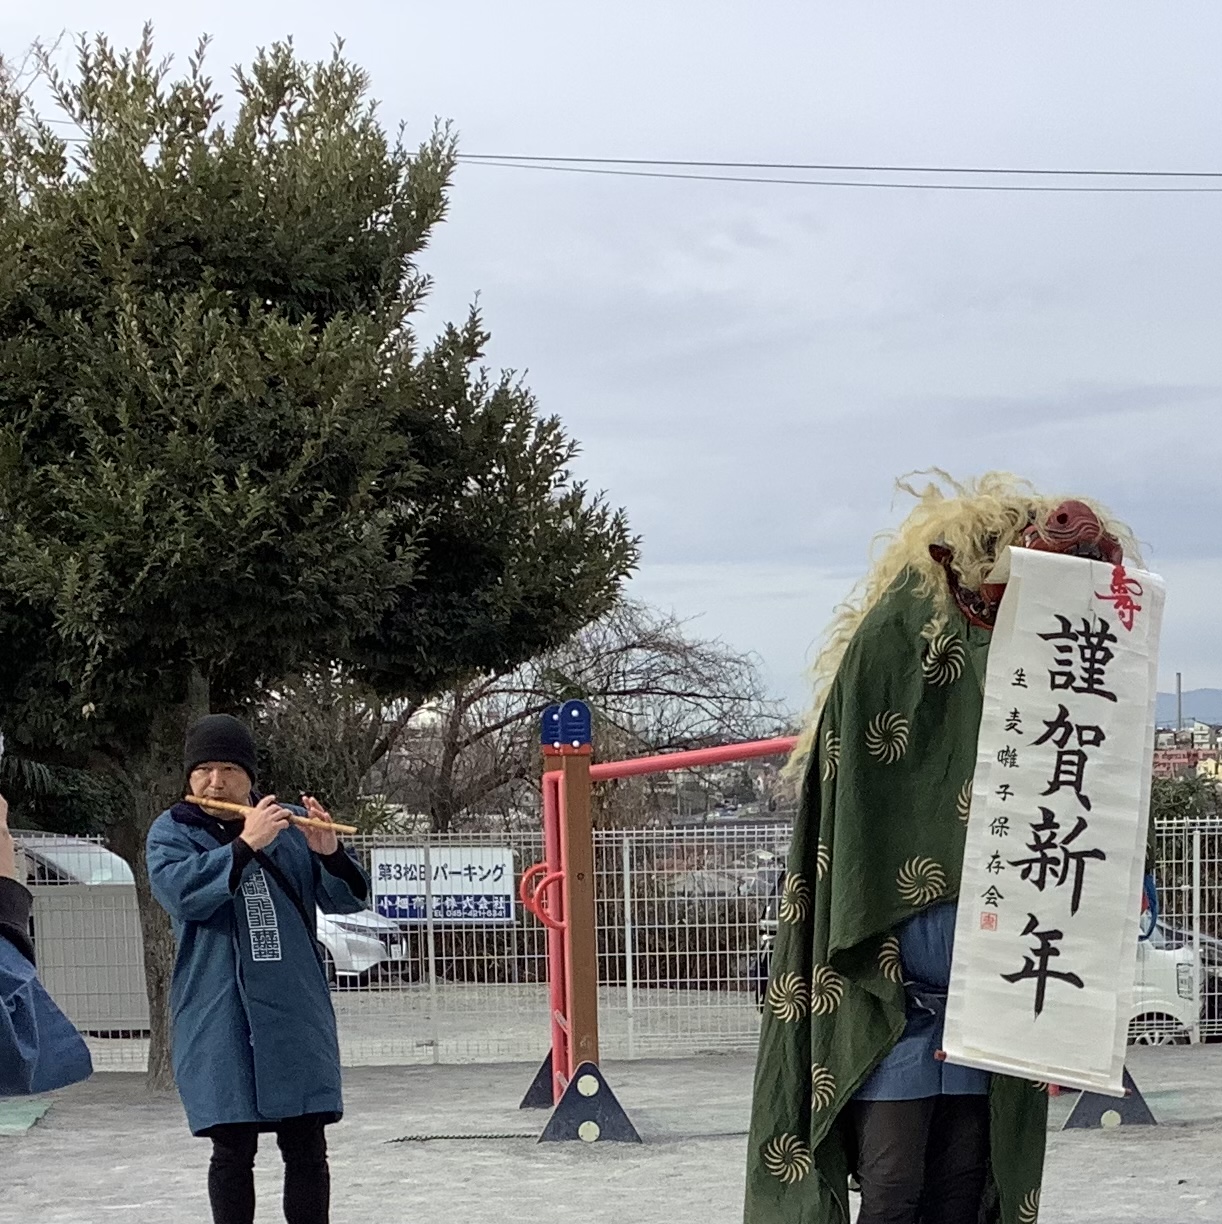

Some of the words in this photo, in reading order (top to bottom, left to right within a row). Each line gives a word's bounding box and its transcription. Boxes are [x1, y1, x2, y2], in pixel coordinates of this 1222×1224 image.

[980, 667, 1028, 908] 生麦囃子保存会
[1000, 613, 1119, 1021] 謹賀新年
